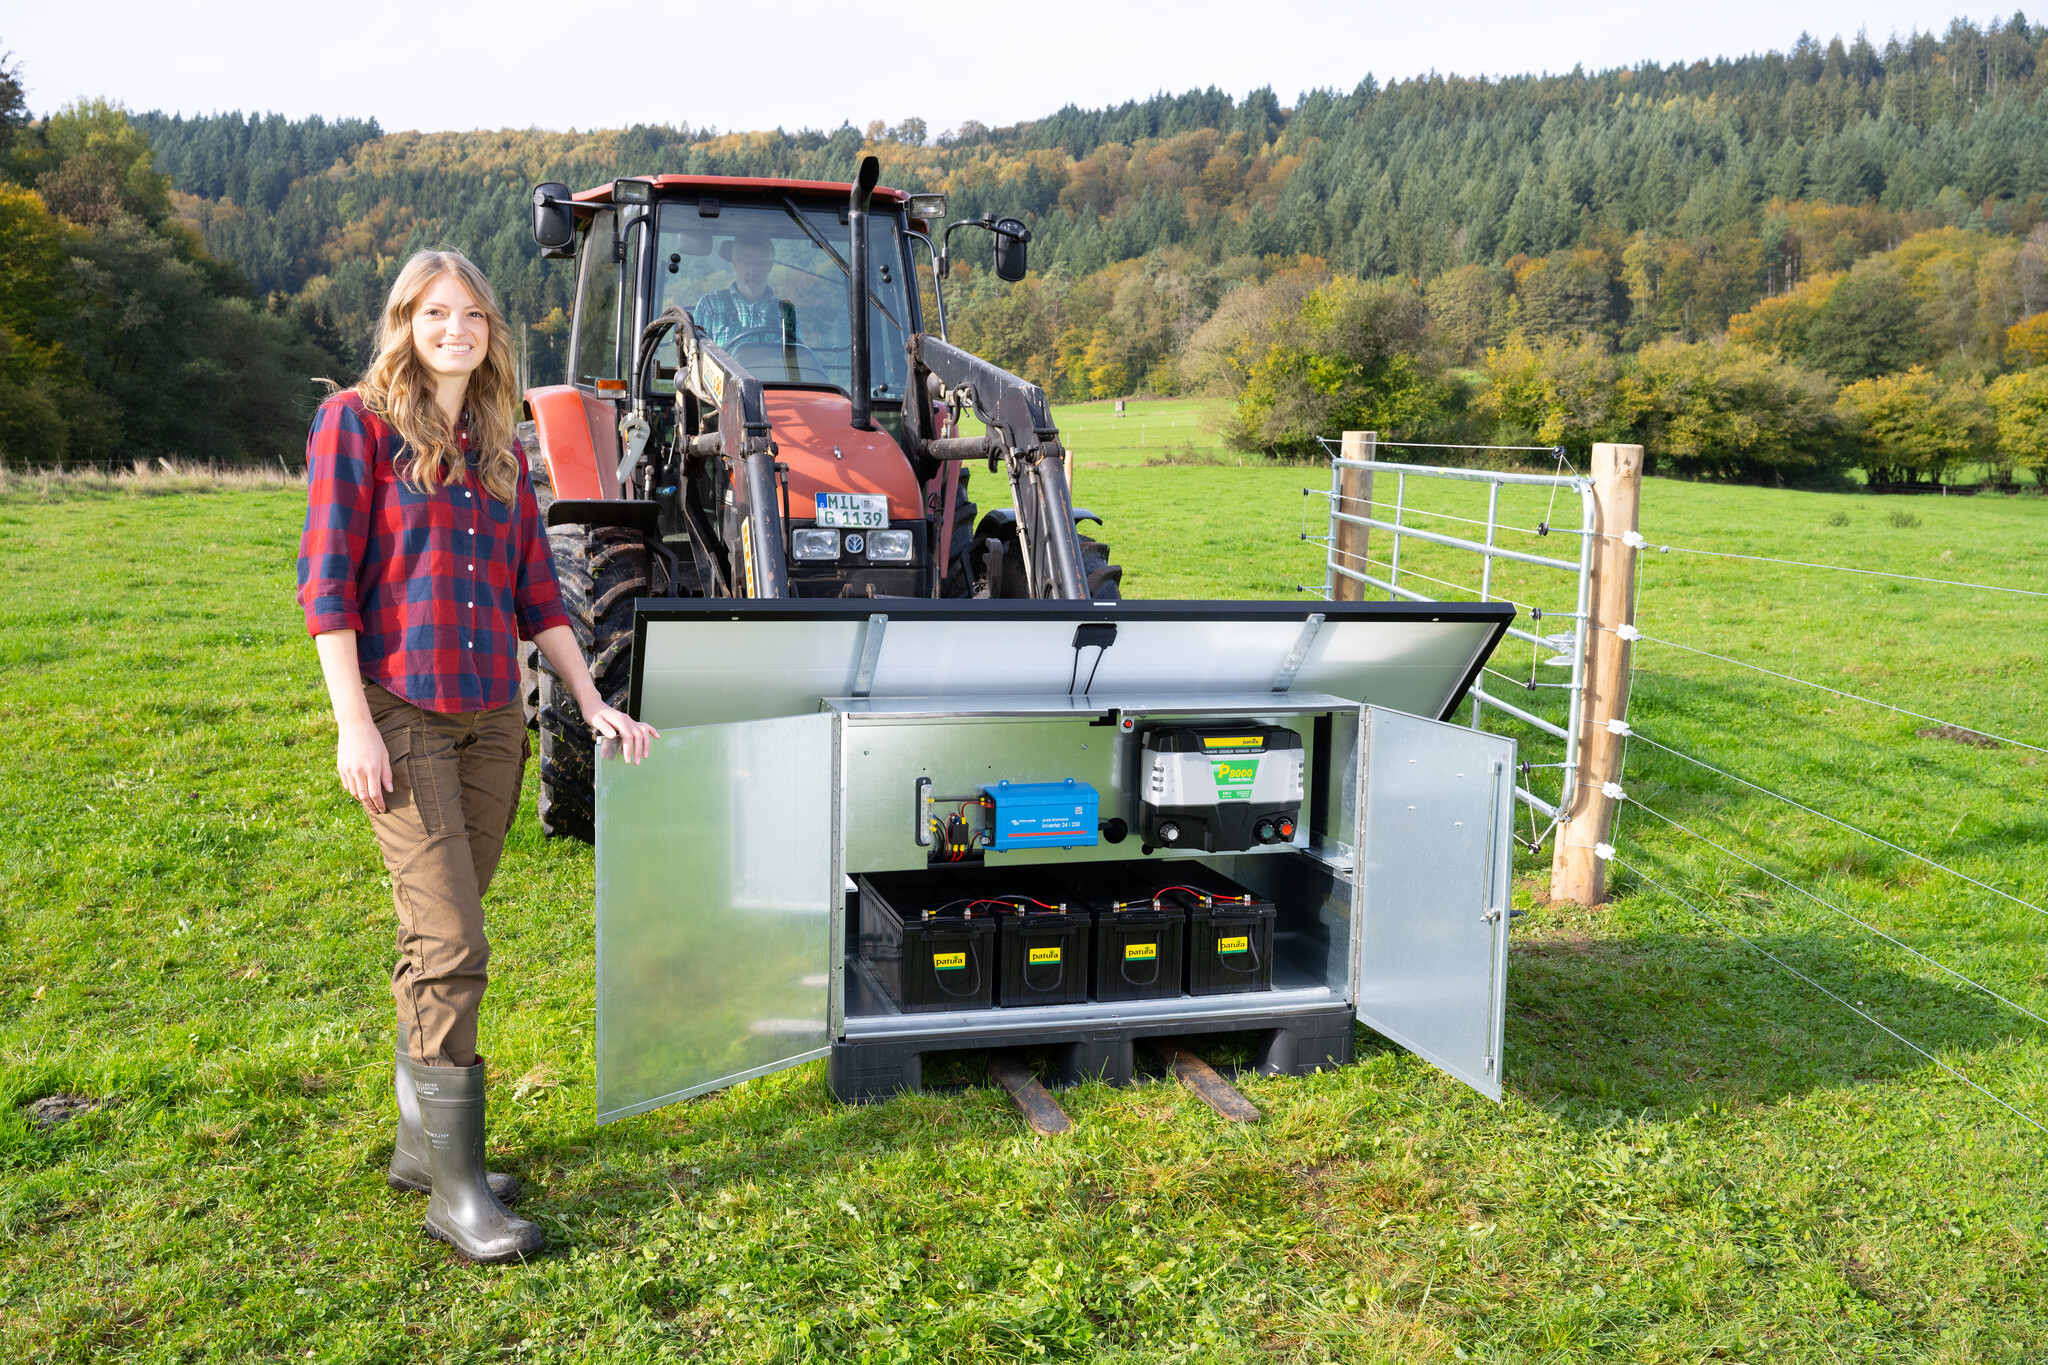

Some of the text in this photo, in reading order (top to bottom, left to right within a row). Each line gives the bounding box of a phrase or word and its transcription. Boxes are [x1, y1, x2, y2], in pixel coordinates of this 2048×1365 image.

[828, 495, 860, 510] MIL
[824, 511, 882, 526] G 1139
[1032, 952, 1059, 960] patura
[1128, 948, 1153, 956] patura
[936, 957, 962, 966] patura
